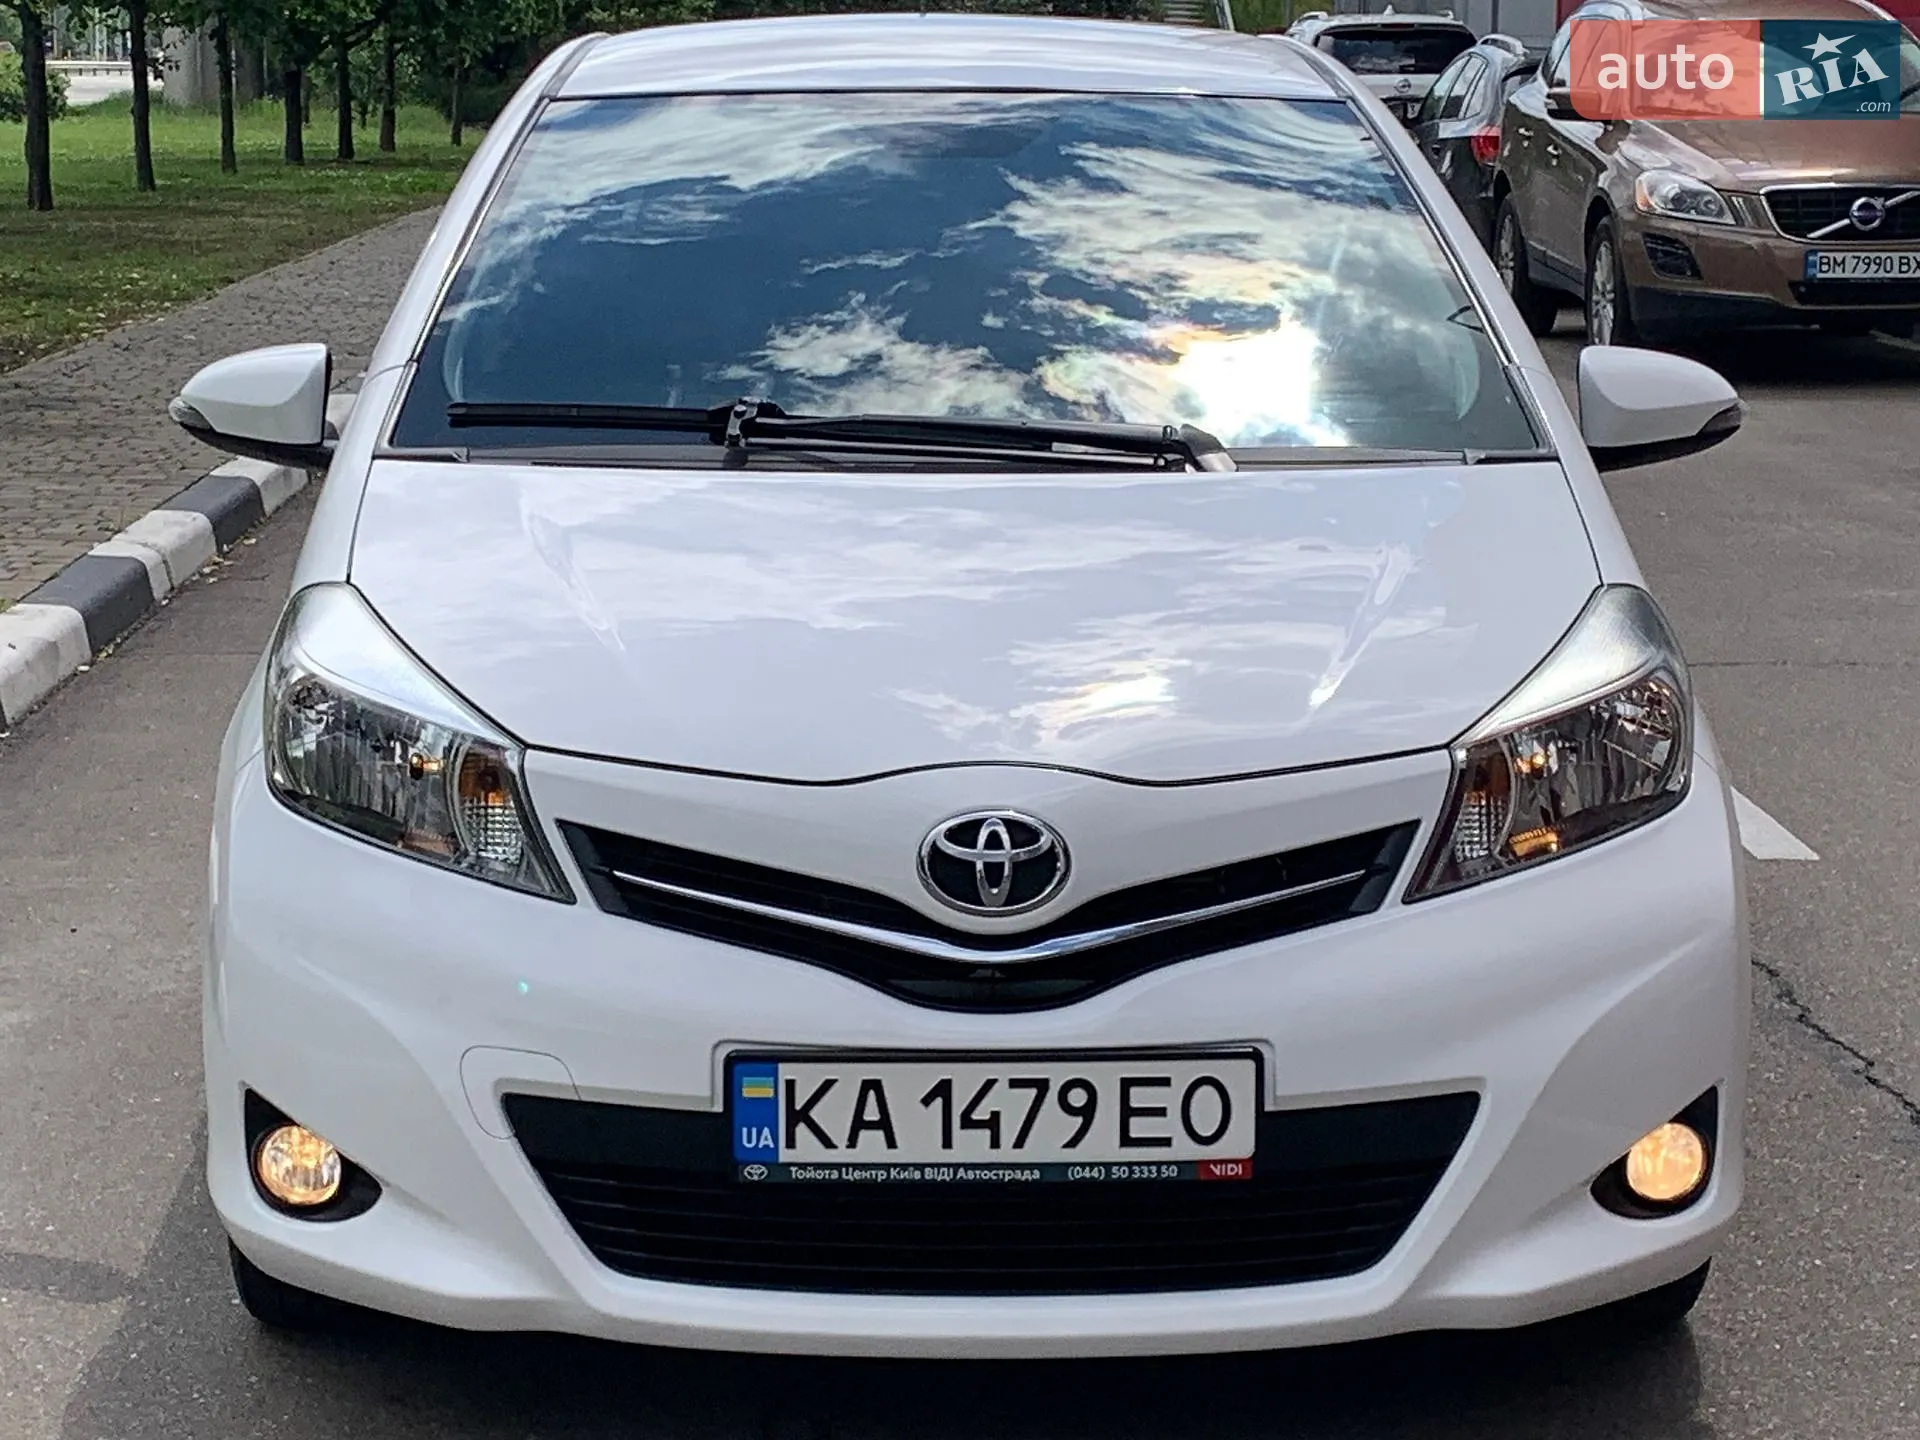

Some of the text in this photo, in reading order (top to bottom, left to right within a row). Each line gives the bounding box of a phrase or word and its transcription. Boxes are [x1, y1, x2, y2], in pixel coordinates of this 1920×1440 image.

[1819, 255, 1846, 274] BM
[1851, 255, 1893, 274] 7990
[784, 1075, 1232, 1150] KA 1479 EO
[742, 1127, 775, 1149] UA
[790, 1167, 839, 1179] Тойота
[842, 1167, 887, 1181] Центр
[890, 1167, 921, 1179] Київ
[956, 1167, 1040, 1182] Автострада
[1067, 1165, 1178, 1180] (044) 50 333 50
